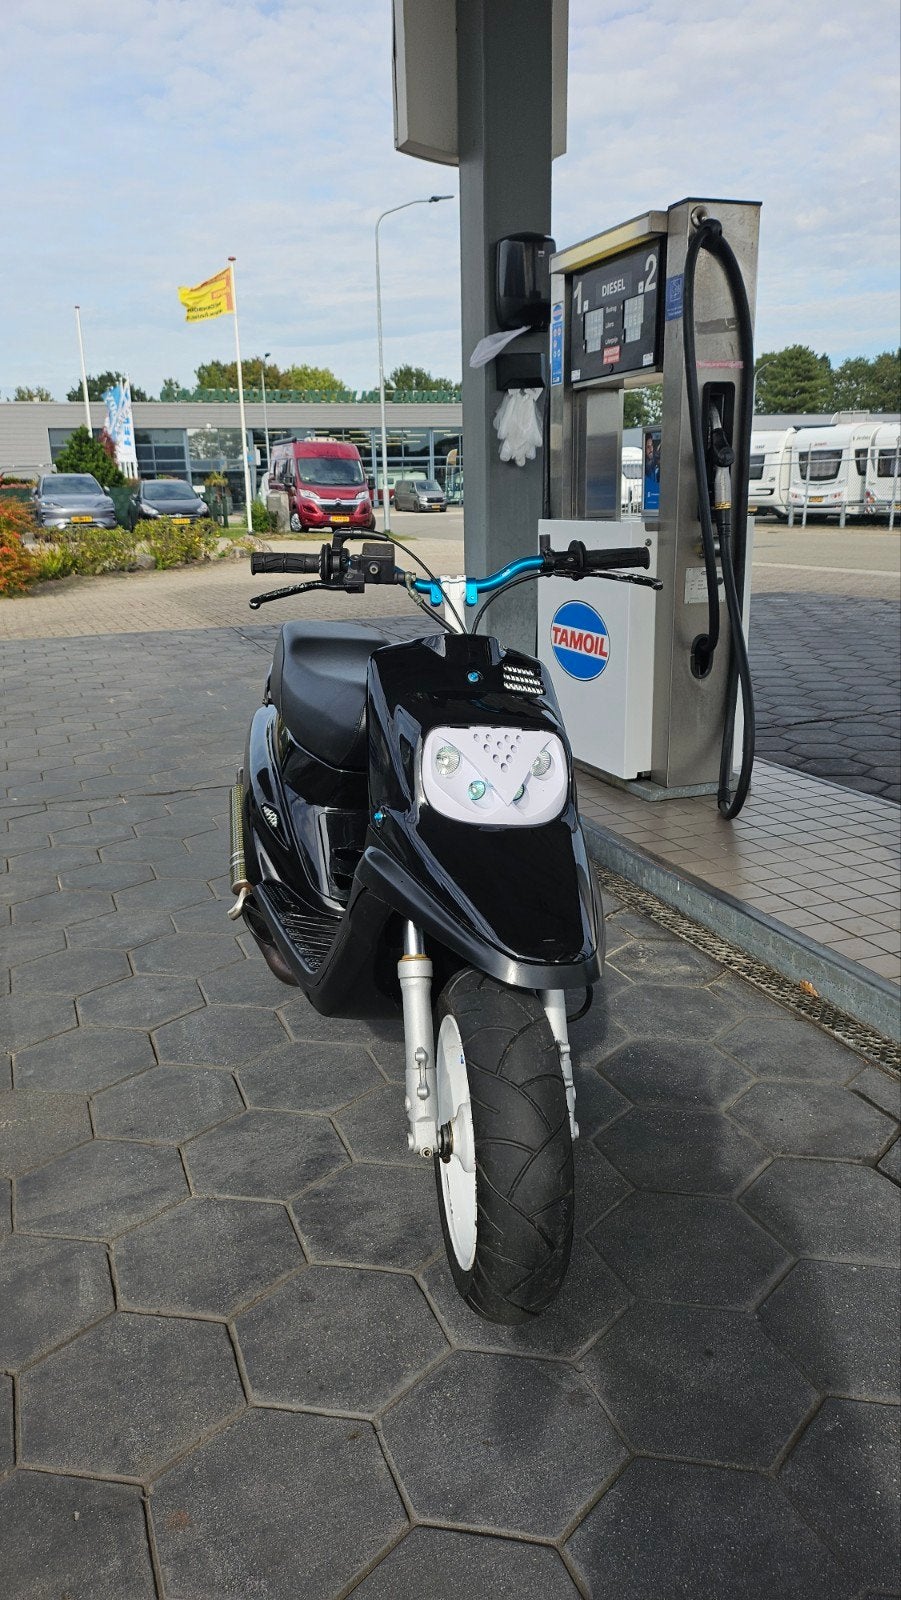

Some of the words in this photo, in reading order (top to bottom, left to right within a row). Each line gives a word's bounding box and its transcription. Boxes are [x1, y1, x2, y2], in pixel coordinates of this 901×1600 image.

[601, 278, 626, 297] DIESEL
[644, 254, 658, 292] 2
[573, 281, 583, 315] 1
[552, 626, 608, 658] TAMOIL
